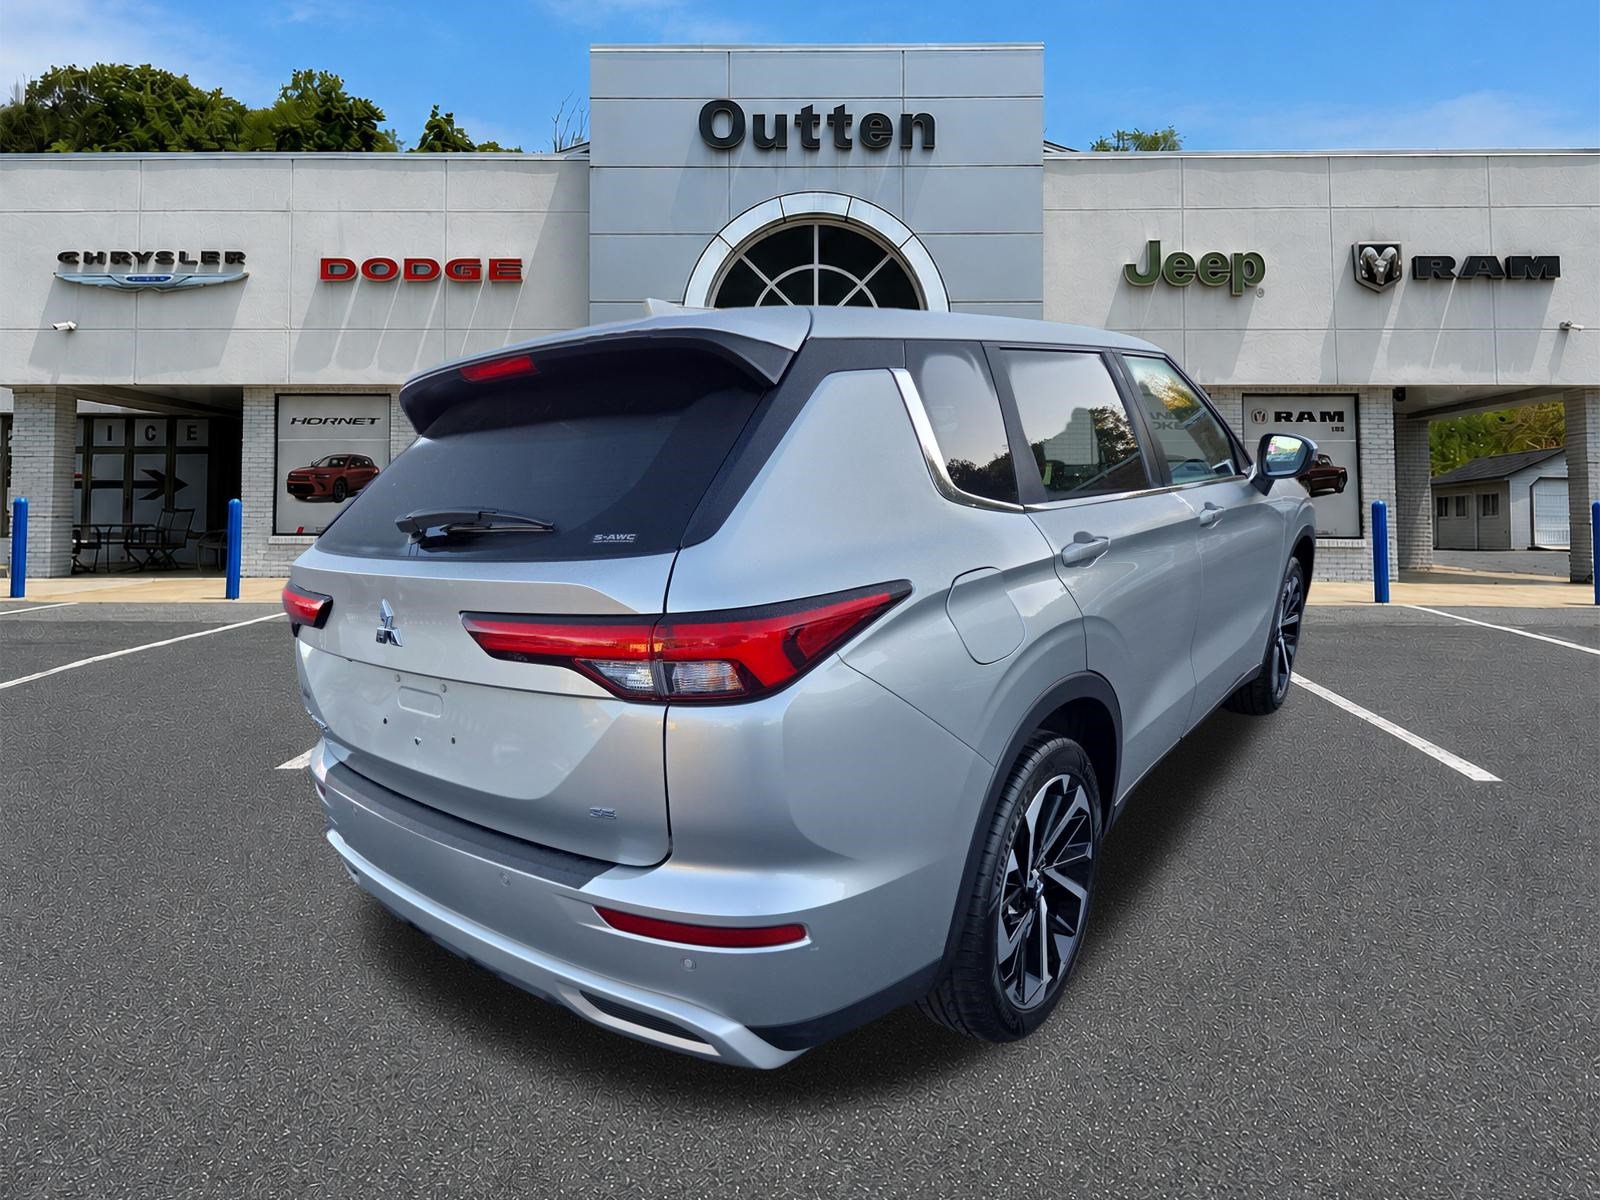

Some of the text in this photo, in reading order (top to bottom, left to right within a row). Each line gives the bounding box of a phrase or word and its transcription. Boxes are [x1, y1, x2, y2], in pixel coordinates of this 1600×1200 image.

[699, 99, 936, 150] Outten
[57, 250, 247, 266] CHRYSLER
[1123, 240, 1266, 296] Jeep
[1411, 256, 1561, 280] RAM
[320, 257, 523, 284] DODGE
[290, 417, 381, 426] HORNET
[1274, 411, 1345, 423] RAM
[593, 533, 637, 541] S-AWC
